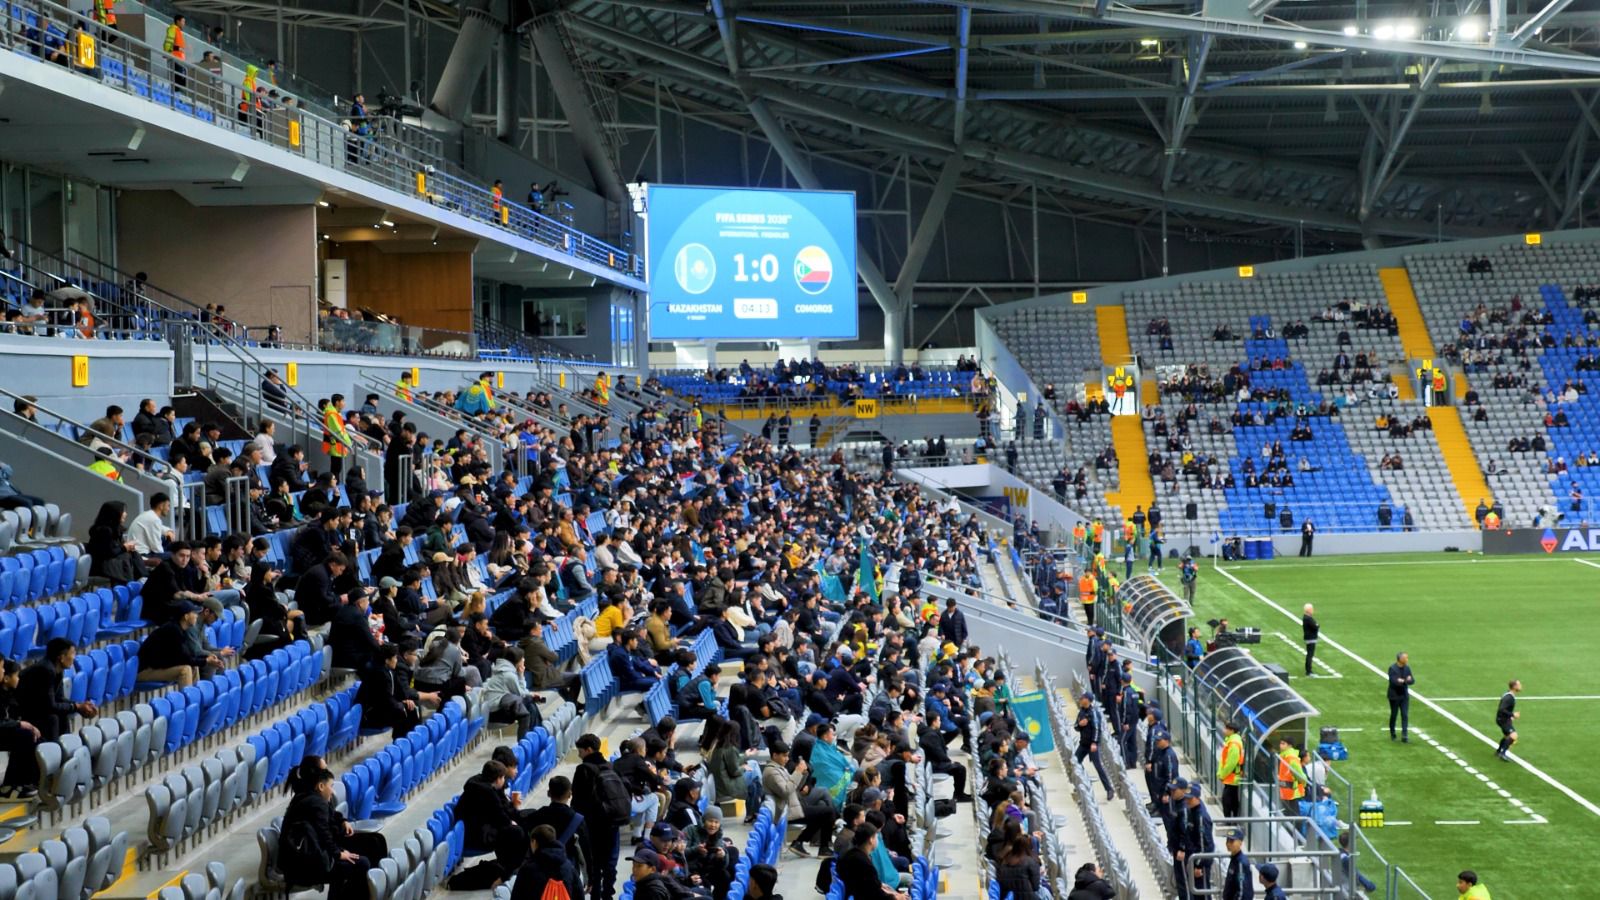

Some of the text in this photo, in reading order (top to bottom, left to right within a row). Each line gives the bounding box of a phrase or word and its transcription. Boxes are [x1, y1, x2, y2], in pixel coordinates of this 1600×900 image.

[733, 253, 779, 282] 1:0
[669, 303, 722, 313] KAZAKHSTAN
[794, 303, 833, 314] COMOROS
[1422, 359, 1432, 370] N
[1115, 367, 1125, 378] N
[1108, 376, 1134, 387] 7 6
[857, 404, 874, 414] NW
